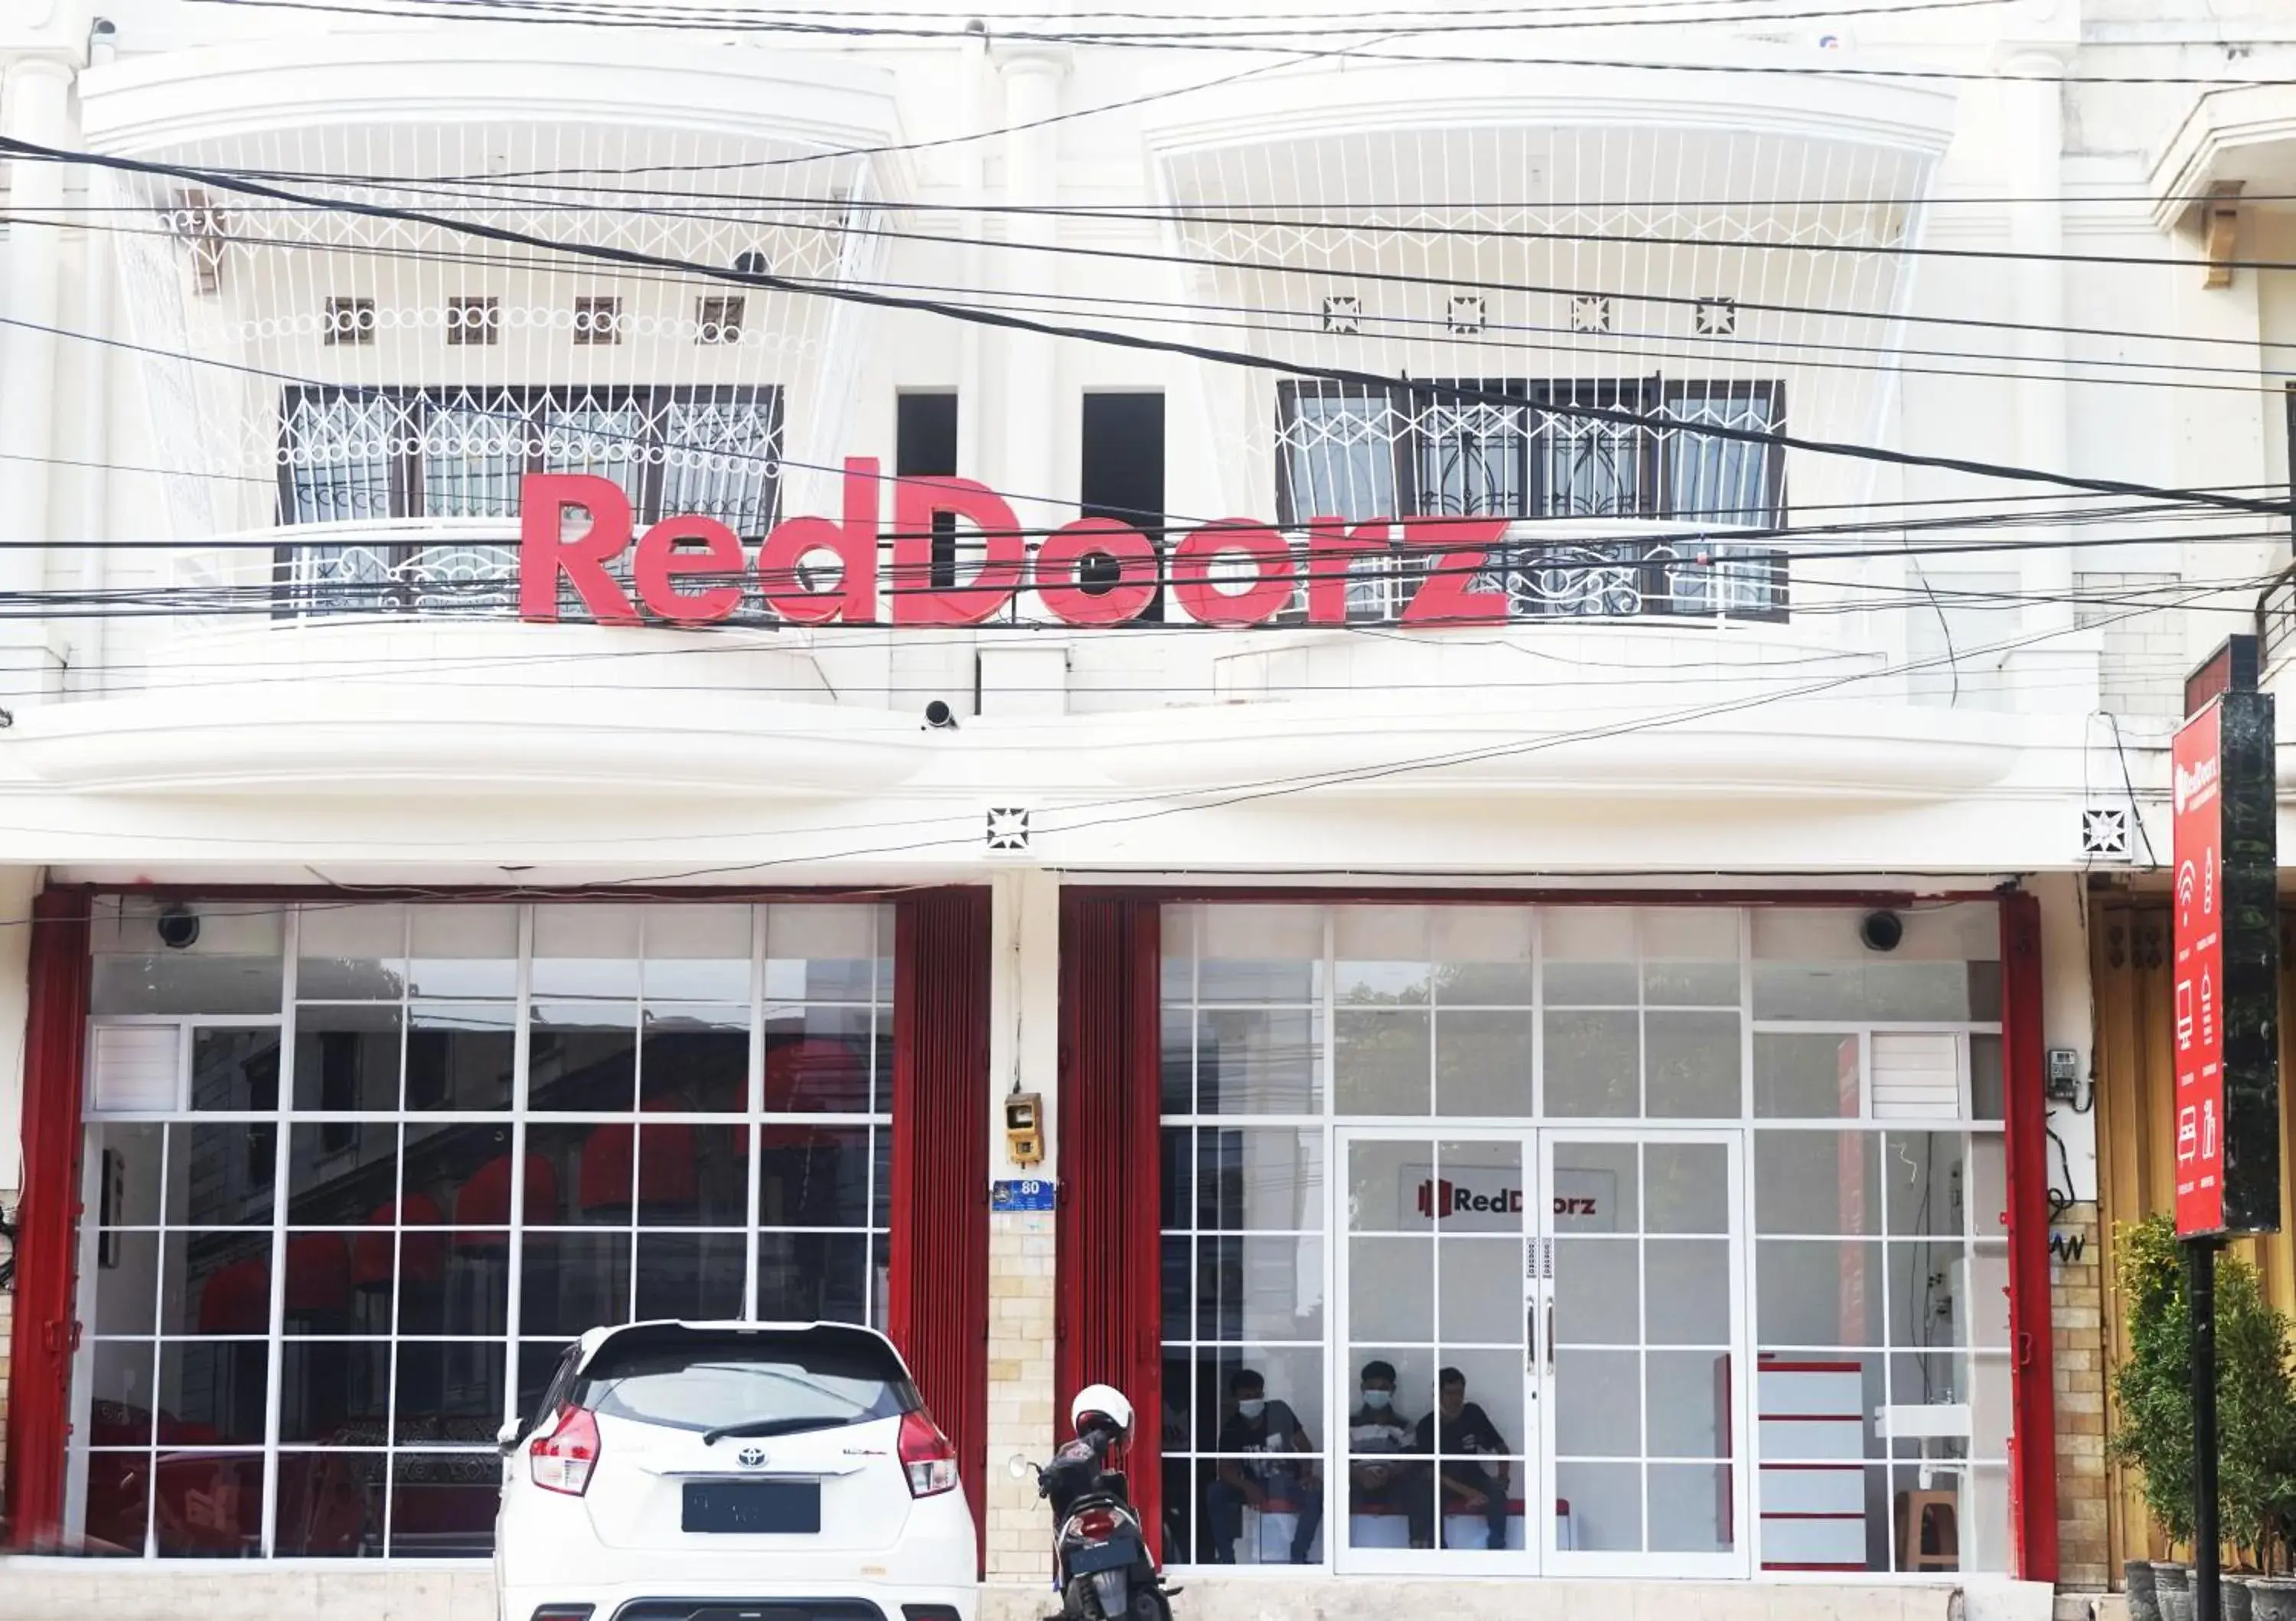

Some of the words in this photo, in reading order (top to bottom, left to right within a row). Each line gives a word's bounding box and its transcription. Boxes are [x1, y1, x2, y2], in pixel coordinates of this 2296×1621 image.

[520, 457, 1511, 626] RedDoorz
[1022, 1181, 1039, 1194] 80
[1454, 1188, 1596, 1215] RedDorz
